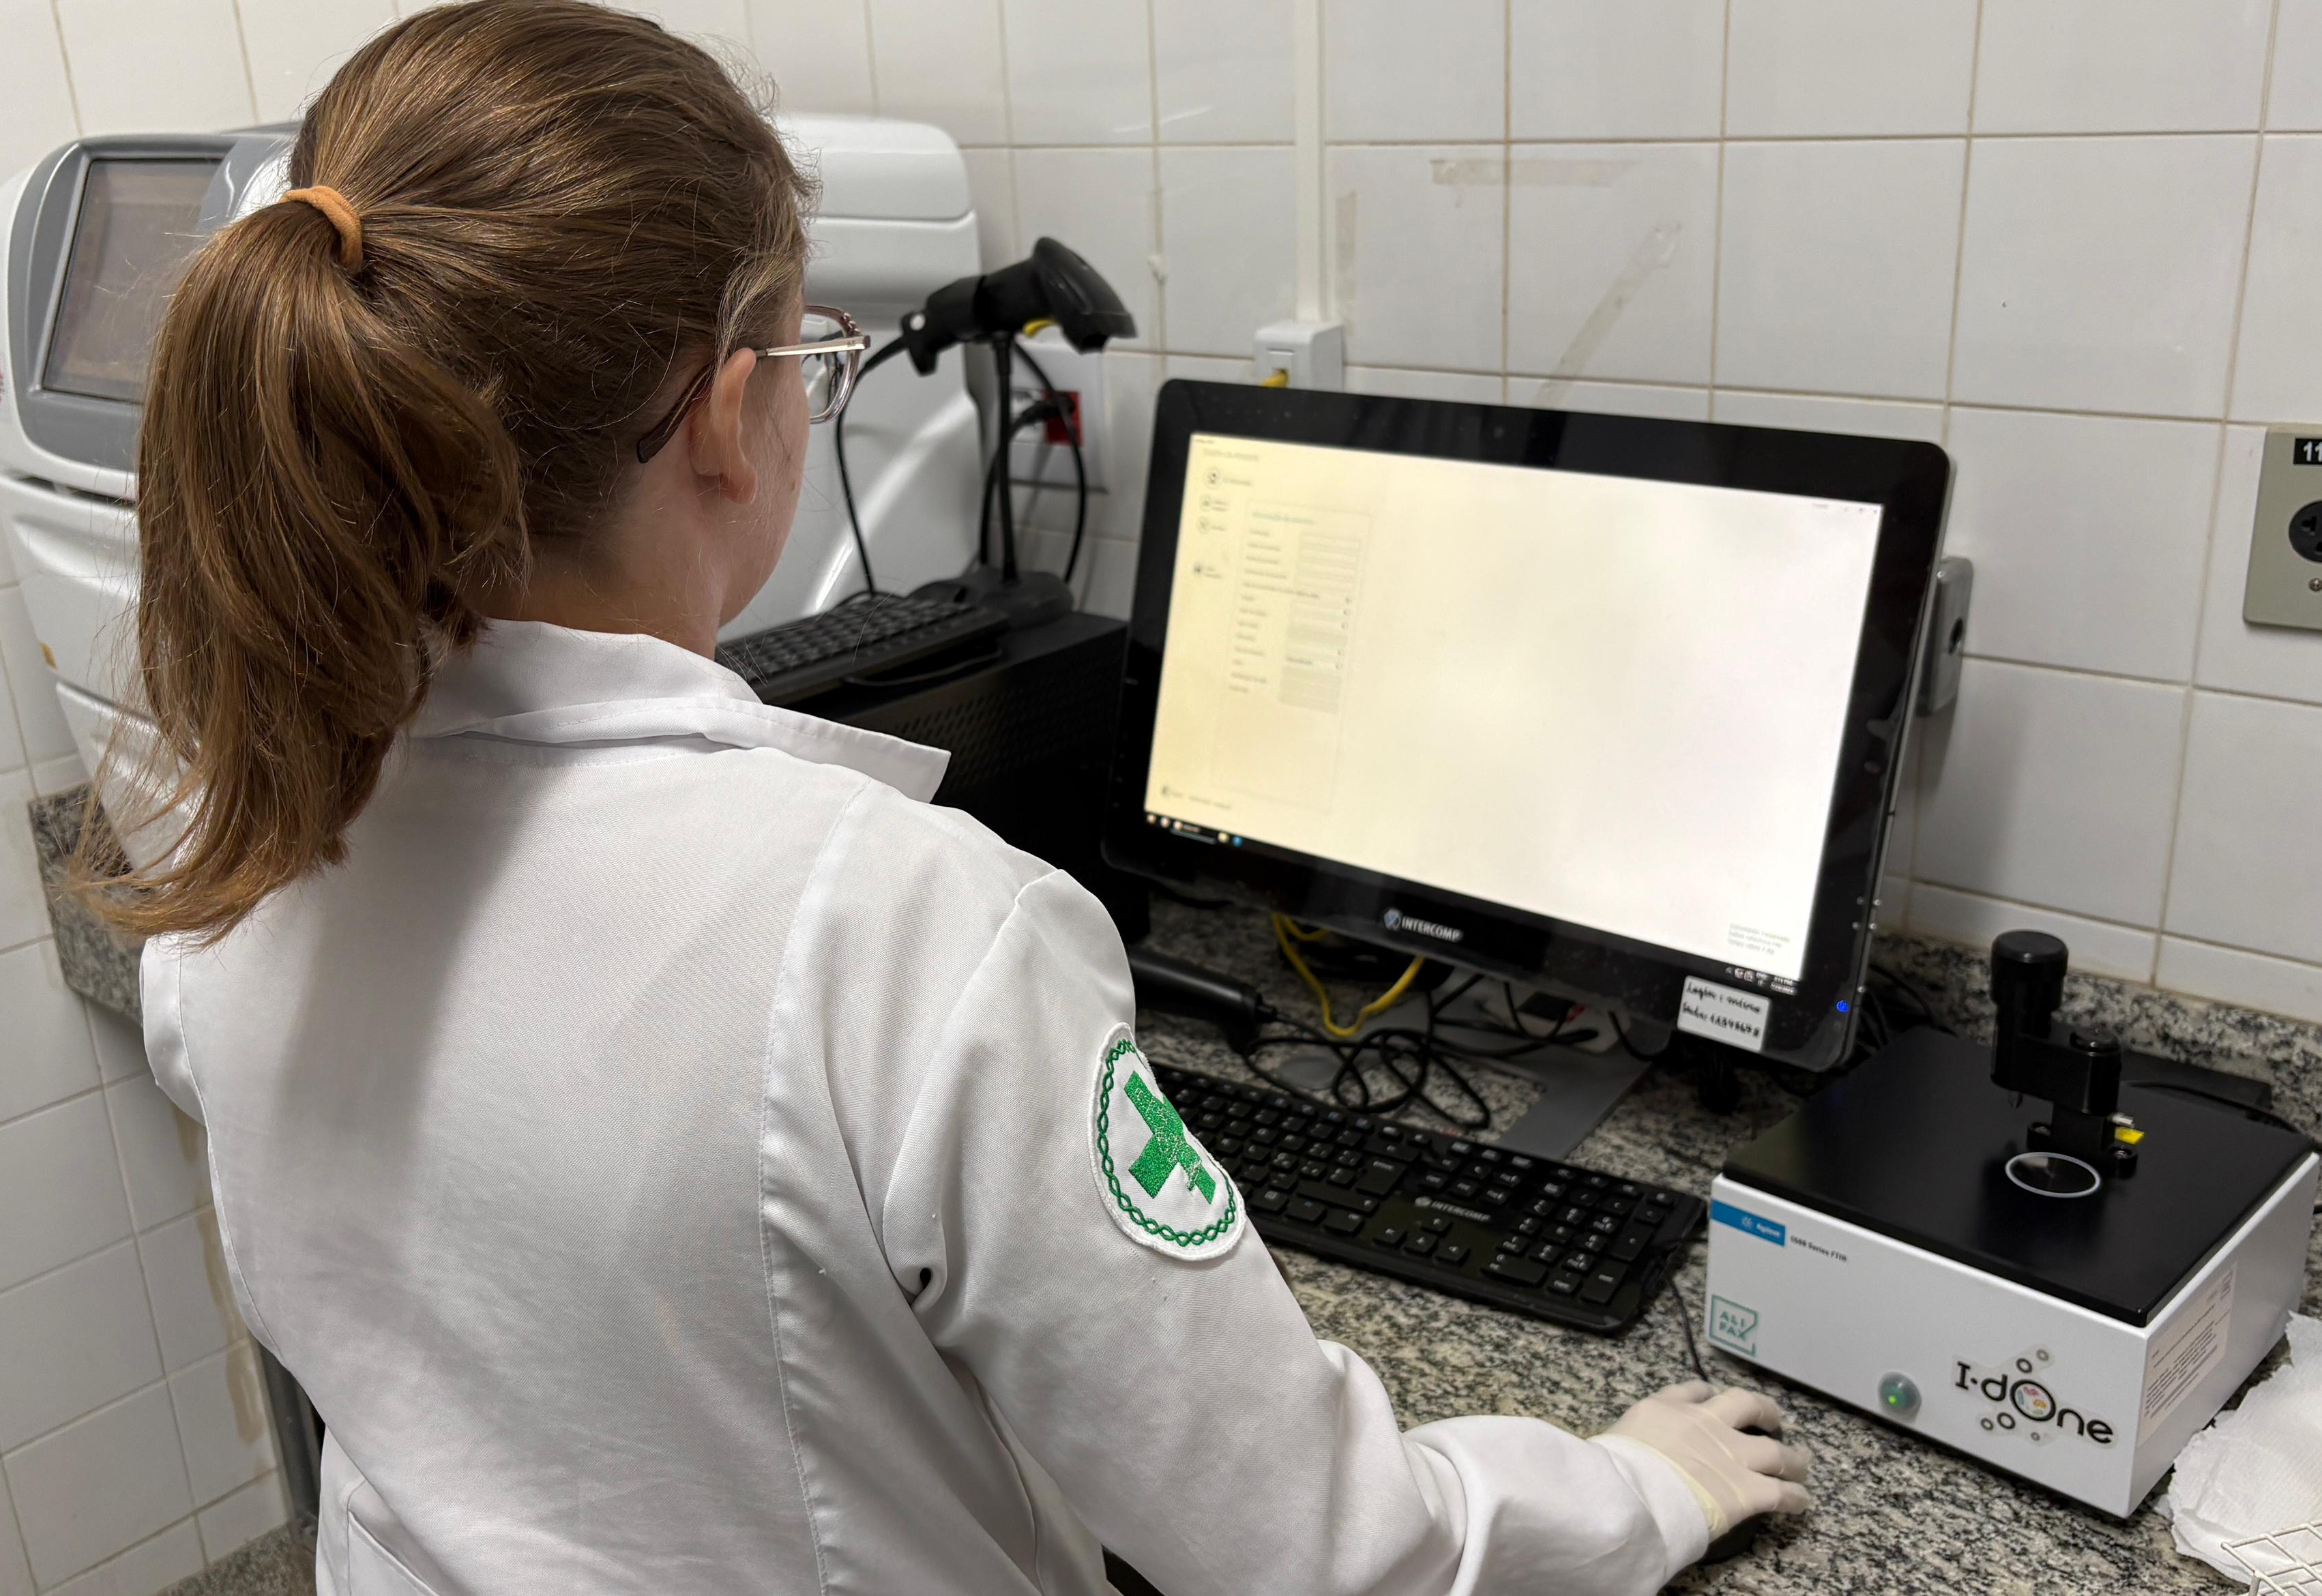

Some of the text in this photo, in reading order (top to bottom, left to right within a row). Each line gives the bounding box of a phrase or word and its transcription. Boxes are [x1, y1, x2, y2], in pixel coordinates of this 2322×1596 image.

[1401, 915, 1463, 942] INTERCOMP
[1432, 1201, 1490, 1222] INTERCOMP
[1720, 1311, 1745, 1328] ALI
